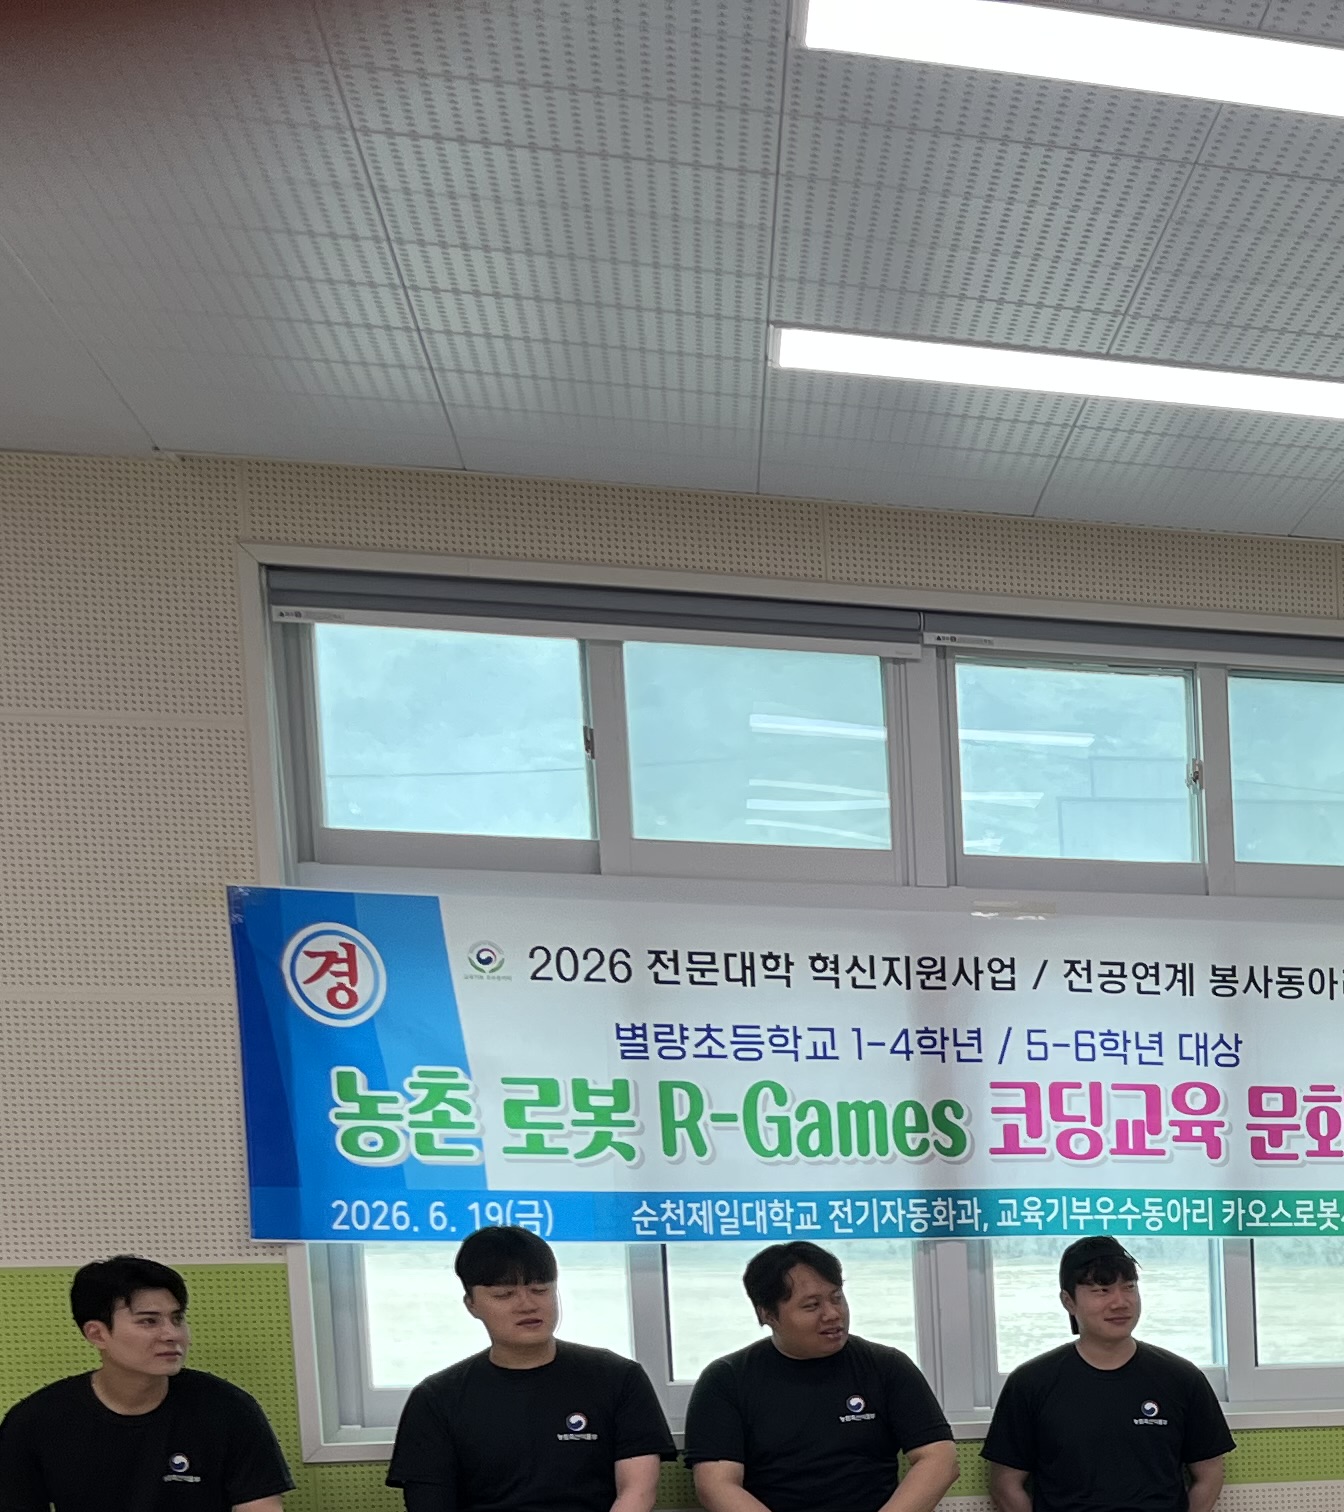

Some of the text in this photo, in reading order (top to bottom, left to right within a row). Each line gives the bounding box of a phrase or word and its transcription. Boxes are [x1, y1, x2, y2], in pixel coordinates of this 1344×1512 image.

[302, 942, 358, 1010] 경
[528, 945, 633, 983] 2026
[647, 949, 795, 989] 전문대학
[808, 952, 1017, 991] 혁신지원사업
[1032, 958, 1049, 990] /
[1063, 958, 1195, 997] 전공연계
[614, 1022, 1243, 1068] 별량초등학교 1-4학년 / 5-6학년 대상
[332, 1069, 478, 1158] 농촌
[500, 1076, 637, 1163] 로봇
[658, 1079, 968, 1159] R-Games
[988, 1081, 1226, 1161] 코딩교육
[331, 1200, 420, 1232] 2026.
[428, 1200, 457, 1232] 6.
[467, 1199, 554, 1237] 19(금)
[631, 1199, 822, 1236] 순천제일대학교
[828, 1197, 989, 1234] 전기자동화과,
[996, 1196, 1214, 1232] 교육기부우수동아리
